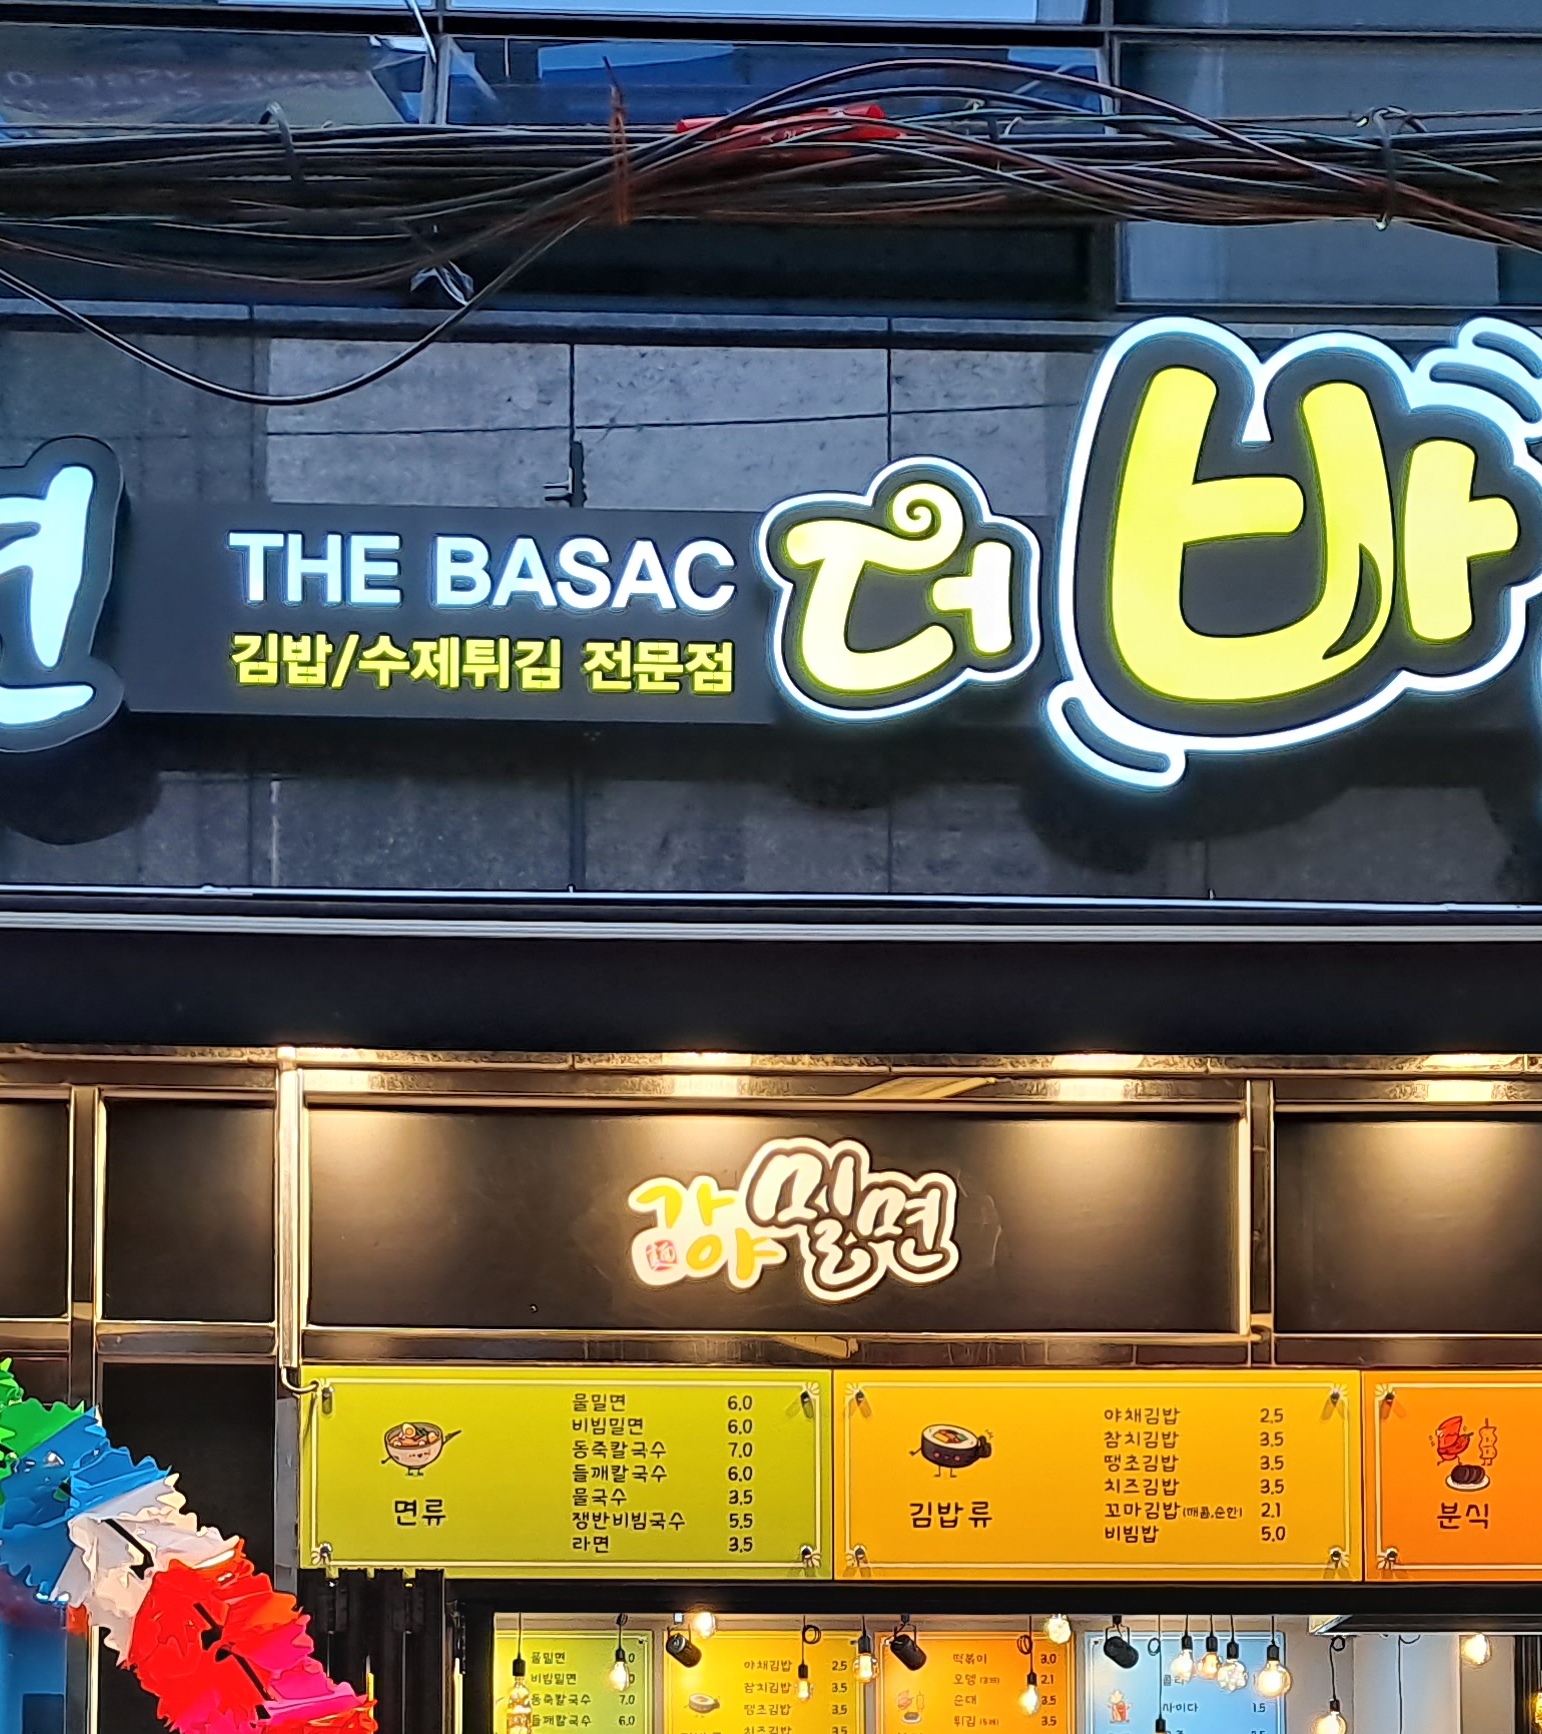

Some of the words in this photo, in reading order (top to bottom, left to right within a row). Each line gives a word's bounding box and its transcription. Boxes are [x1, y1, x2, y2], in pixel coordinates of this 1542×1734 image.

[228, 531, 403, 604] THE
[433, 535, 739, 612] BASAC
[784, 480, 1014, 695] 더
[229, 632, 562, 692] 김밥/수제튀김
[581, 638, 737, 694] 전문점
[633, 1183, 779, 1281] 가야
[745, 1145, 949, 1294] 밀면
[572, 1392, 626, 1412] 물밀면
[727, 1395, 753, 1412] 6.0
[1103, 1407, 1181, 1426] 야채김밥
[1259, 1407, 1284, 1424] 2.5
[572, 1417, 643, 1436] 비빔밀면
[727, 1418, 753, 1435] 6.0
[1103, 1430, 1180, 1449] 참치김밥
[1259, 1431, 1284, 1448] 3.5
[728, 1442, 753, 1459] 7.0
[1103, 1454, 1180, 1473] 땡초김밥
[1260, 1455, 1284, 1471] 3.5
[572, 1463, 668, 1484] 들깨칼국수
[727, 1465, 753, 1483] 6.0
[572, 1487, 628, 1507] 물국수
[728, 1489, 753, 1506] 3.5
[1104, 1478, 1180, 1497] 치즈김밥
[1260, 1478, 1285, 1495] 3.5
[394, 1499, 447, 1527] 면류
[1104, 1501, 1181, 1521] 꼬마김밥
[1261, 1502, 1281, 1519] 2.1
[1436, 1502, 1489, 1530] 분식
[572, 1511, 686, 1531] 쟁반비빔국수
[729, 1513, 753, 1530] 5.5
[1104, 1525, 1160, 1544] 비빔밥
[1261, 1525, 1286, 1543] 5.0
[572, 1535, 609, 1554] 라면
[728, 1536, 753, 1553] 3.5
[831, 1660, 848, 1671] 2.5
[831, 1682, 848, 1693] 3.5
[831, 1704, 848, 1716] 3.5
